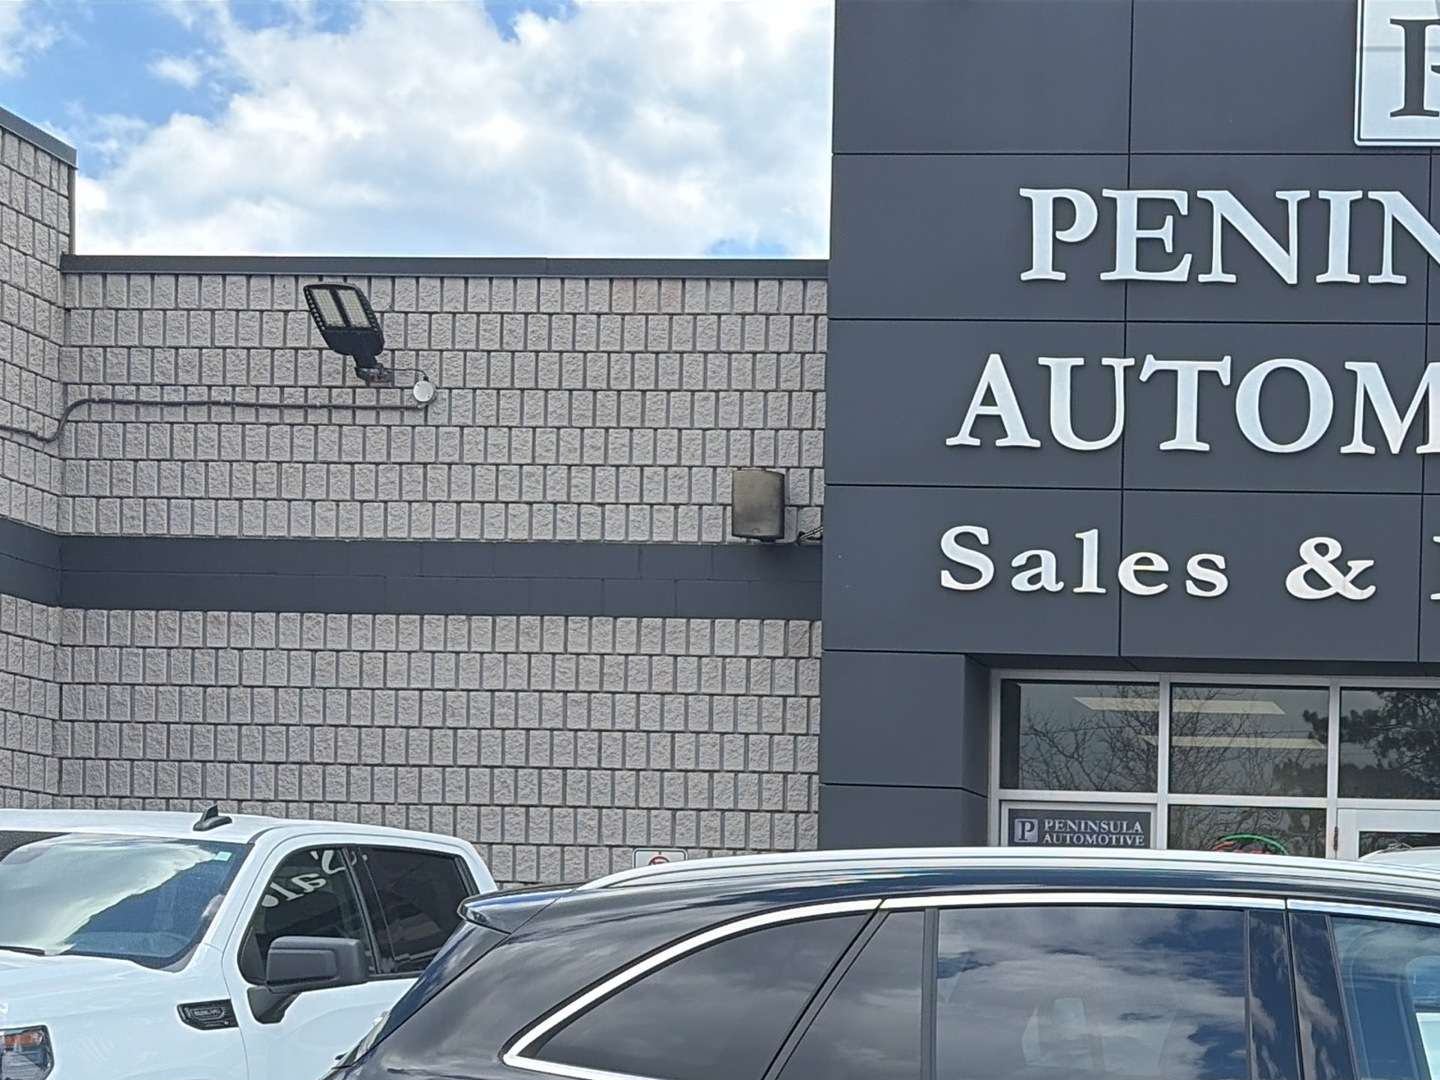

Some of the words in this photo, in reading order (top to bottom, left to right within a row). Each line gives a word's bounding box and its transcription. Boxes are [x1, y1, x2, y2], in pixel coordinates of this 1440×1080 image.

[941, 526, 1228, 596] Sales
[1286, 537, 1376, 599] &
[1043, 819, 1144, 834] PENINSULA
[1042, 833, 1145, 846] AUTOMOTIVE
